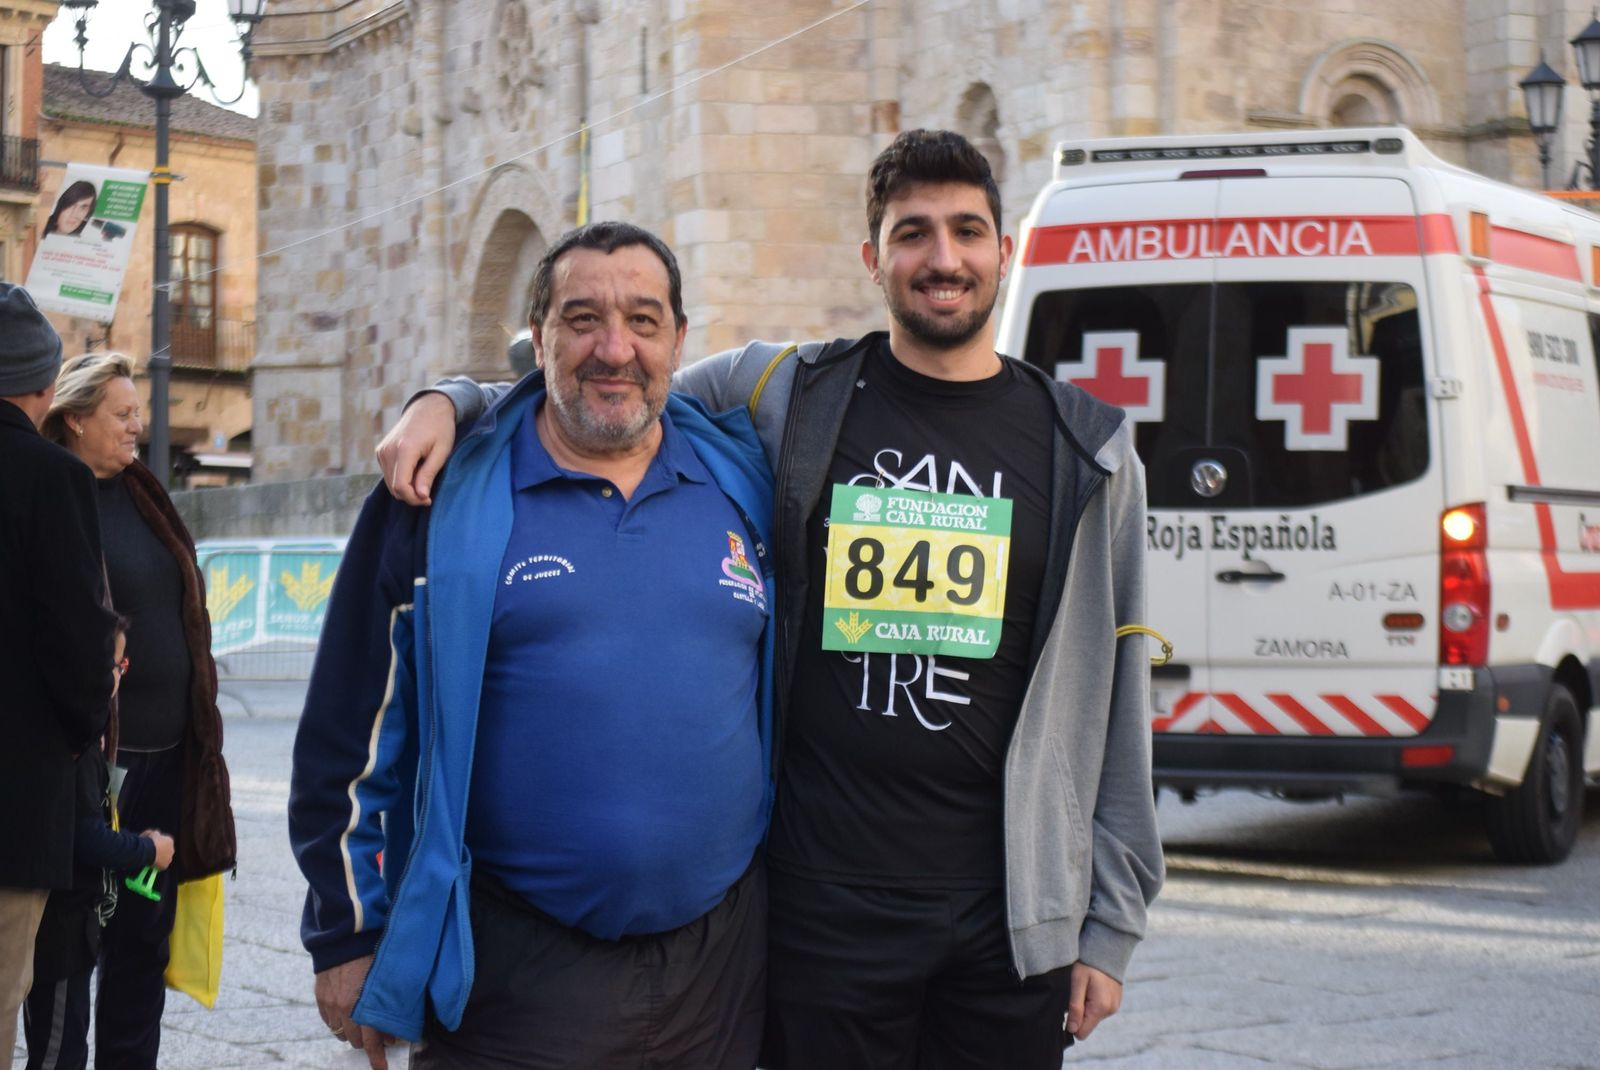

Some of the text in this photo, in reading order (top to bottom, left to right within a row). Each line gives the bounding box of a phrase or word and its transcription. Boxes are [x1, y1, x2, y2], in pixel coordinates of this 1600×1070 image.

[1067, 220, 1374, 264] AMBULANCIA
[887, 497, 988, 518] FUNDACION
[886, 510, 987, 531] CAJA RURAL
[1147, 514, 1336, 560] Roja Española
[845, 537, 986, 606] 849
[1329, 581, 1418, 602] A-01-ZA
[875, 622, 990, 646] CAJA RURAL
[1254, 638, 1351, 659] ZAMORA
